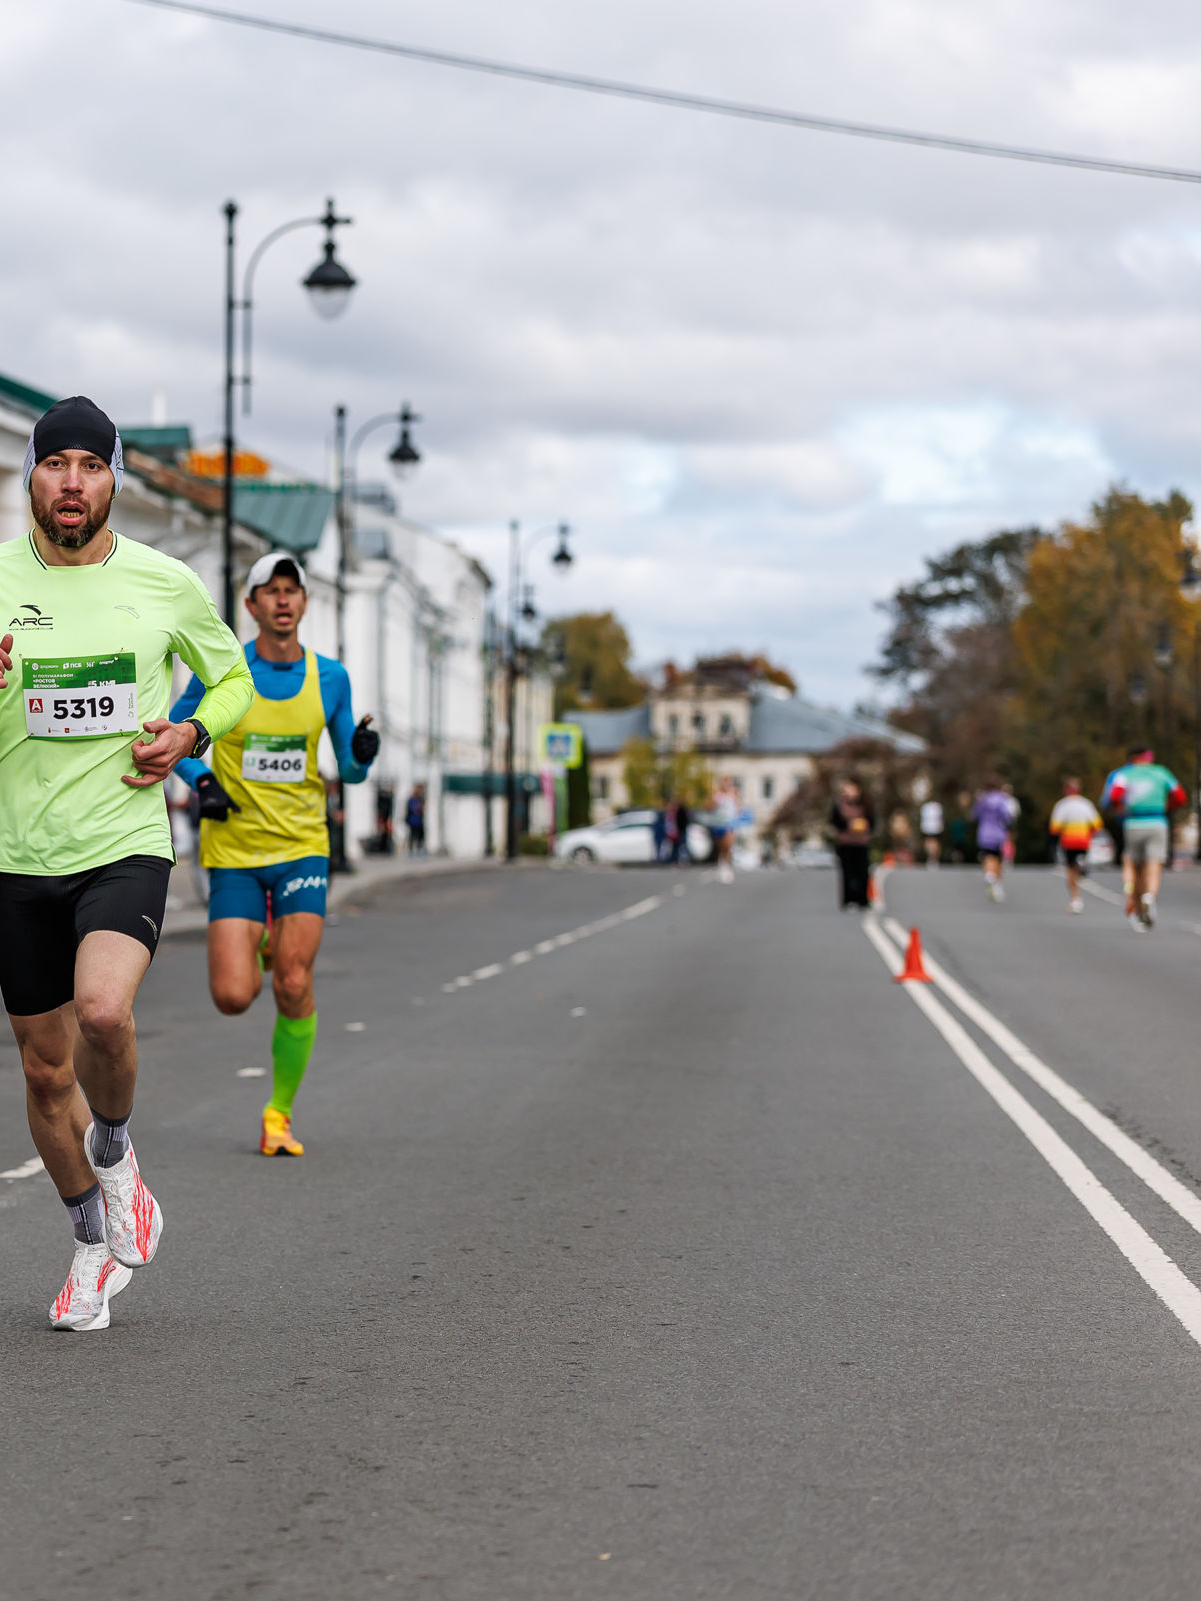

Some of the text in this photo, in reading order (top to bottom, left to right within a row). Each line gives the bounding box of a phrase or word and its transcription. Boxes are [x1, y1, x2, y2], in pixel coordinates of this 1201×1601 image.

[8, 617, 53, 626] ARC
[53, 697, 114, 719] 5319
[258, 759, 302, 771] 5406
